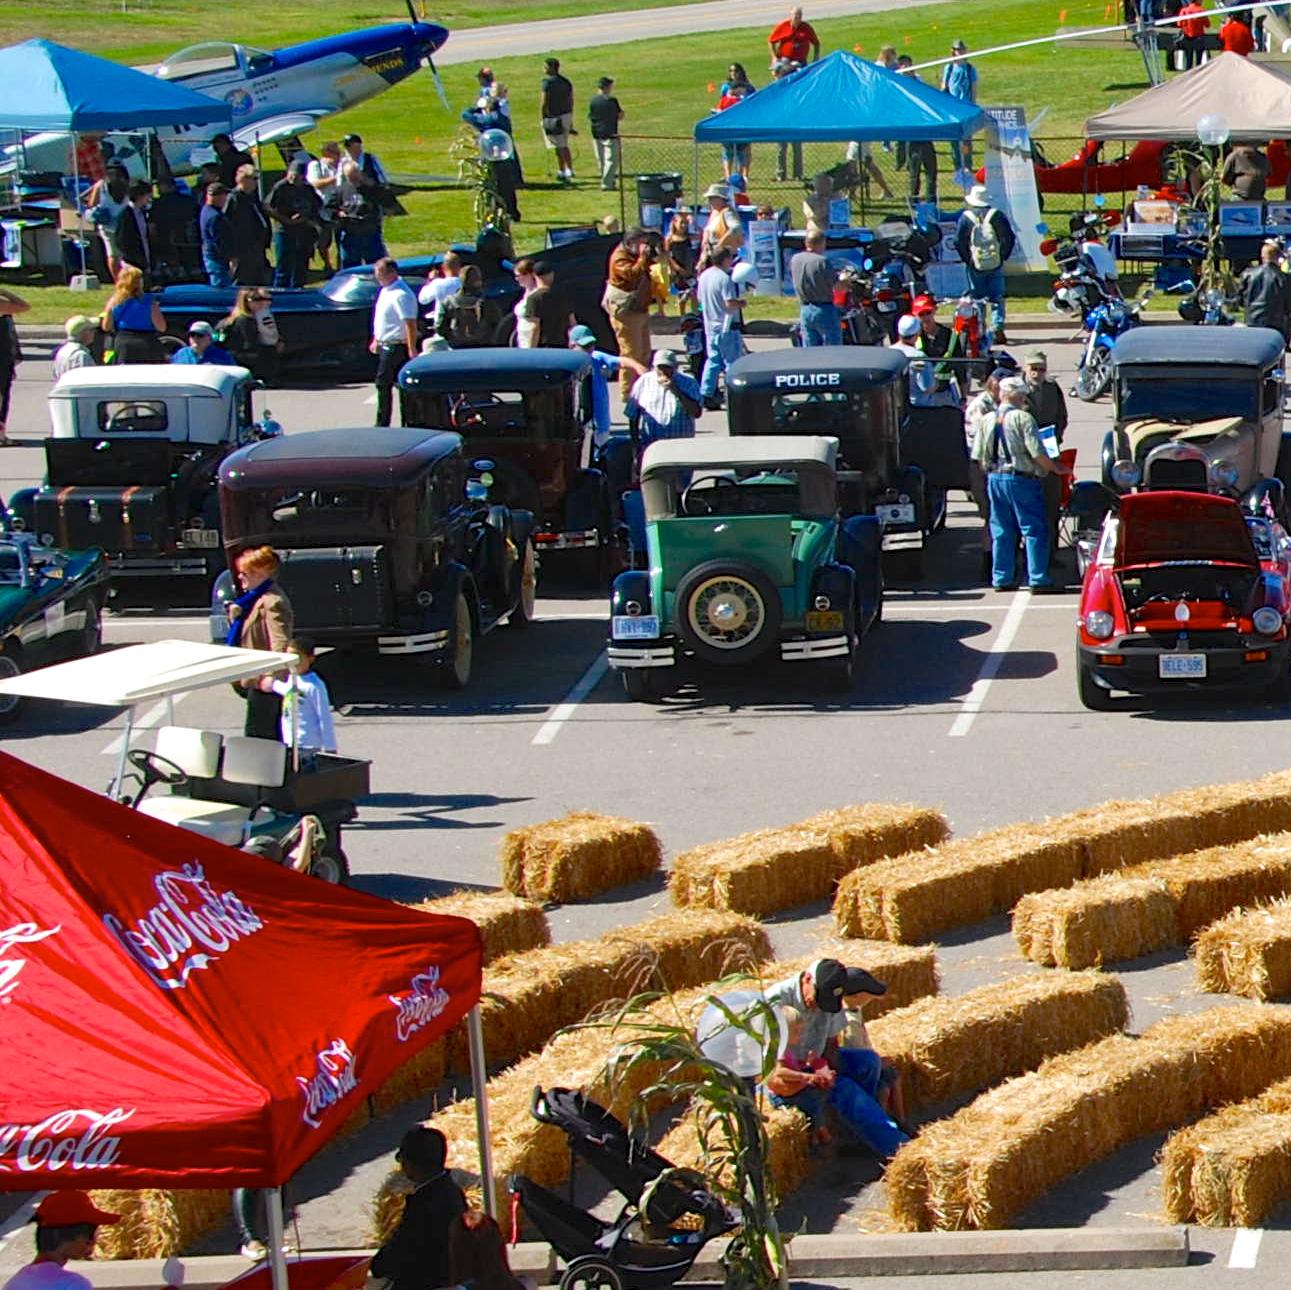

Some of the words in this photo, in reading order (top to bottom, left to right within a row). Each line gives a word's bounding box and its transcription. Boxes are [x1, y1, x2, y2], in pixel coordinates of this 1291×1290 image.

[775, 373, 841, 388] POLICE
[103, 859, 264, 990] Coca-Cola
[0, 1107, 136, 1171] a-Cola
